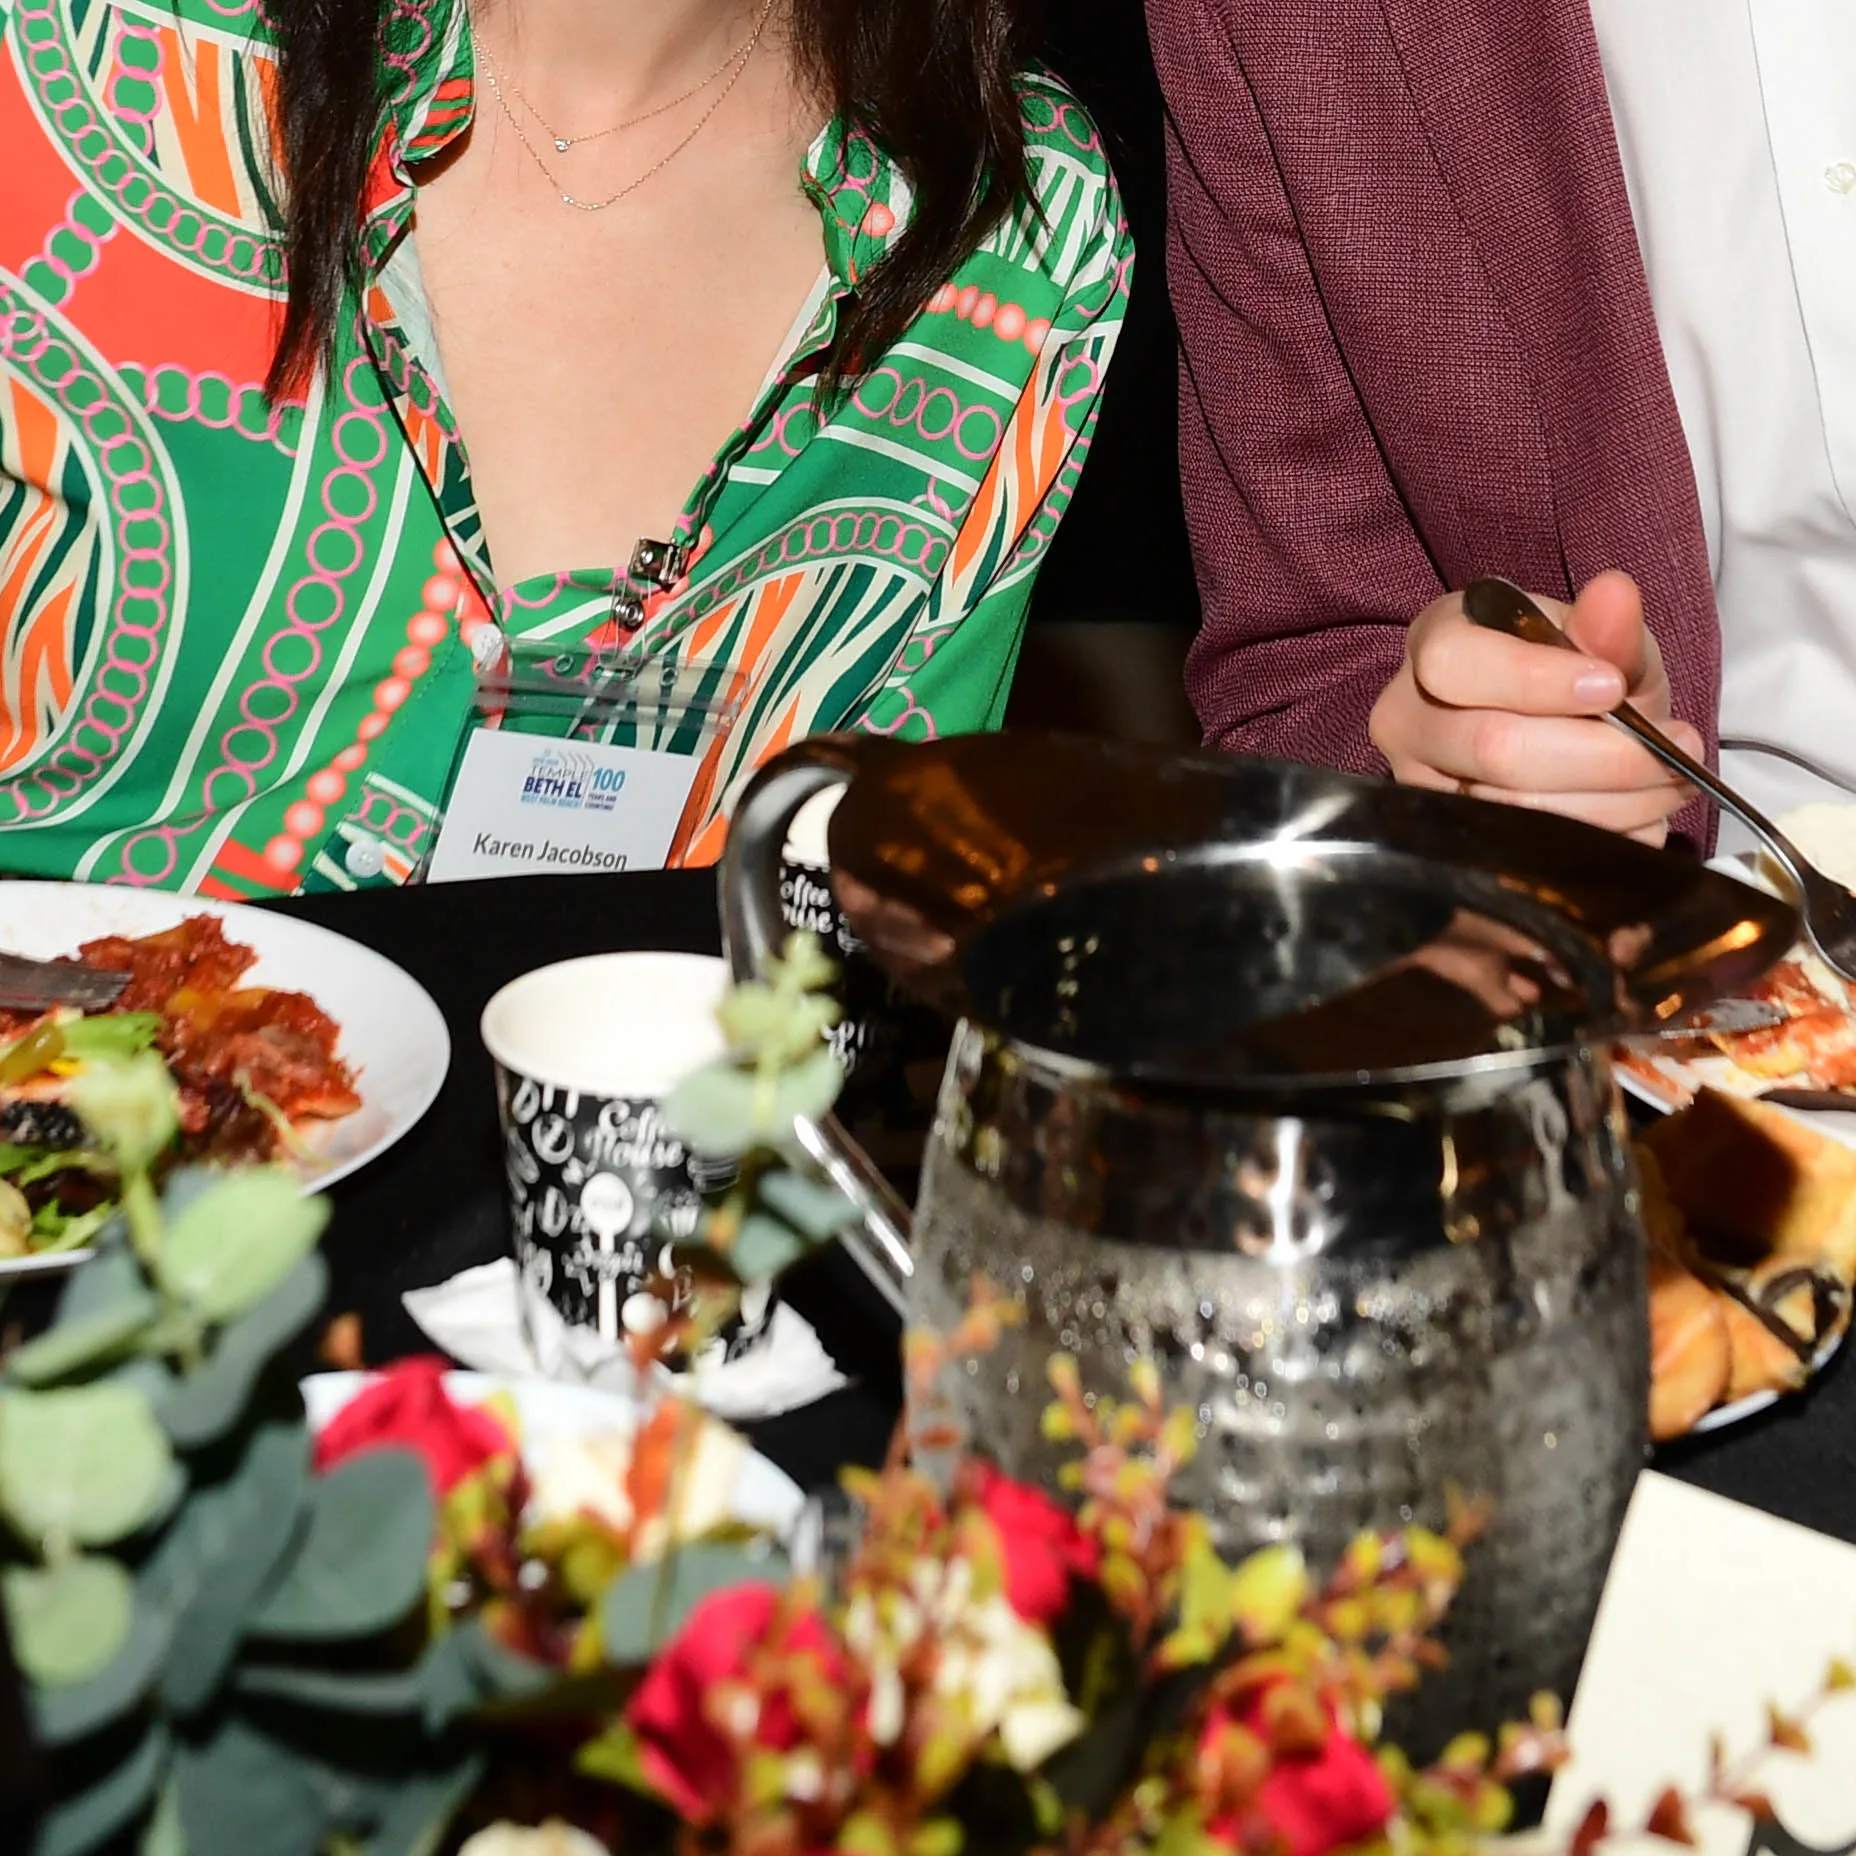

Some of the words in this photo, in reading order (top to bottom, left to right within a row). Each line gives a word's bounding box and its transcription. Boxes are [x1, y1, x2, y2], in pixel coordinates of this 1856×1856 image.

[523, 776, 565, 797] BETH
[565, 780, 582, 799] EL
[531, 765, 587, 781] TEMPLE
[593, 767, 626, 792] 100
[473, 832, 534, 860] Karen
[536, 840, 628, 871] Jacobson
[779, 873, 832, 908] offee
[598, 1100, 670, 1142] Coff
